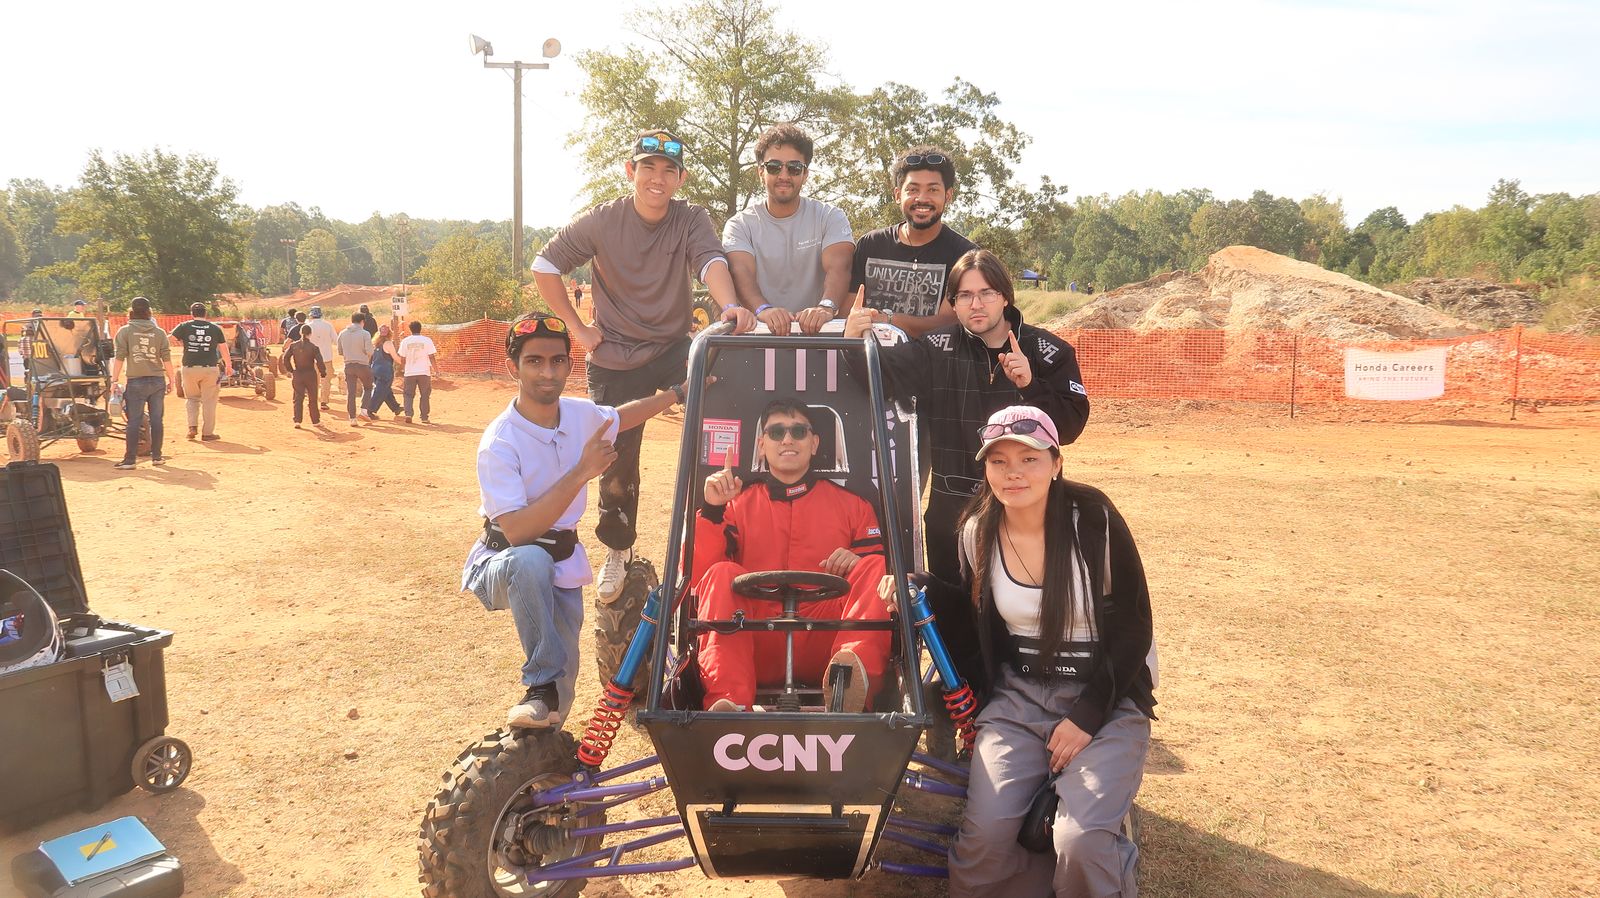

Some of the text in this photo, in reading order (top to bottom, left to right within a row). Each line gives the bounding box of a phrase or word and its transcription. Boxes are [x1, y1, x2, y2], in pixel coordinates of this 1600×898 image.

[866, 266, 941, 286] UNIVERSAL
[877, 280, 938, 296] STUDIOS
[32, 341, 48, 358] 101
[1355, 363, 1434, 371] Honda Careers
[713, 733, 856, 771] CCNY
